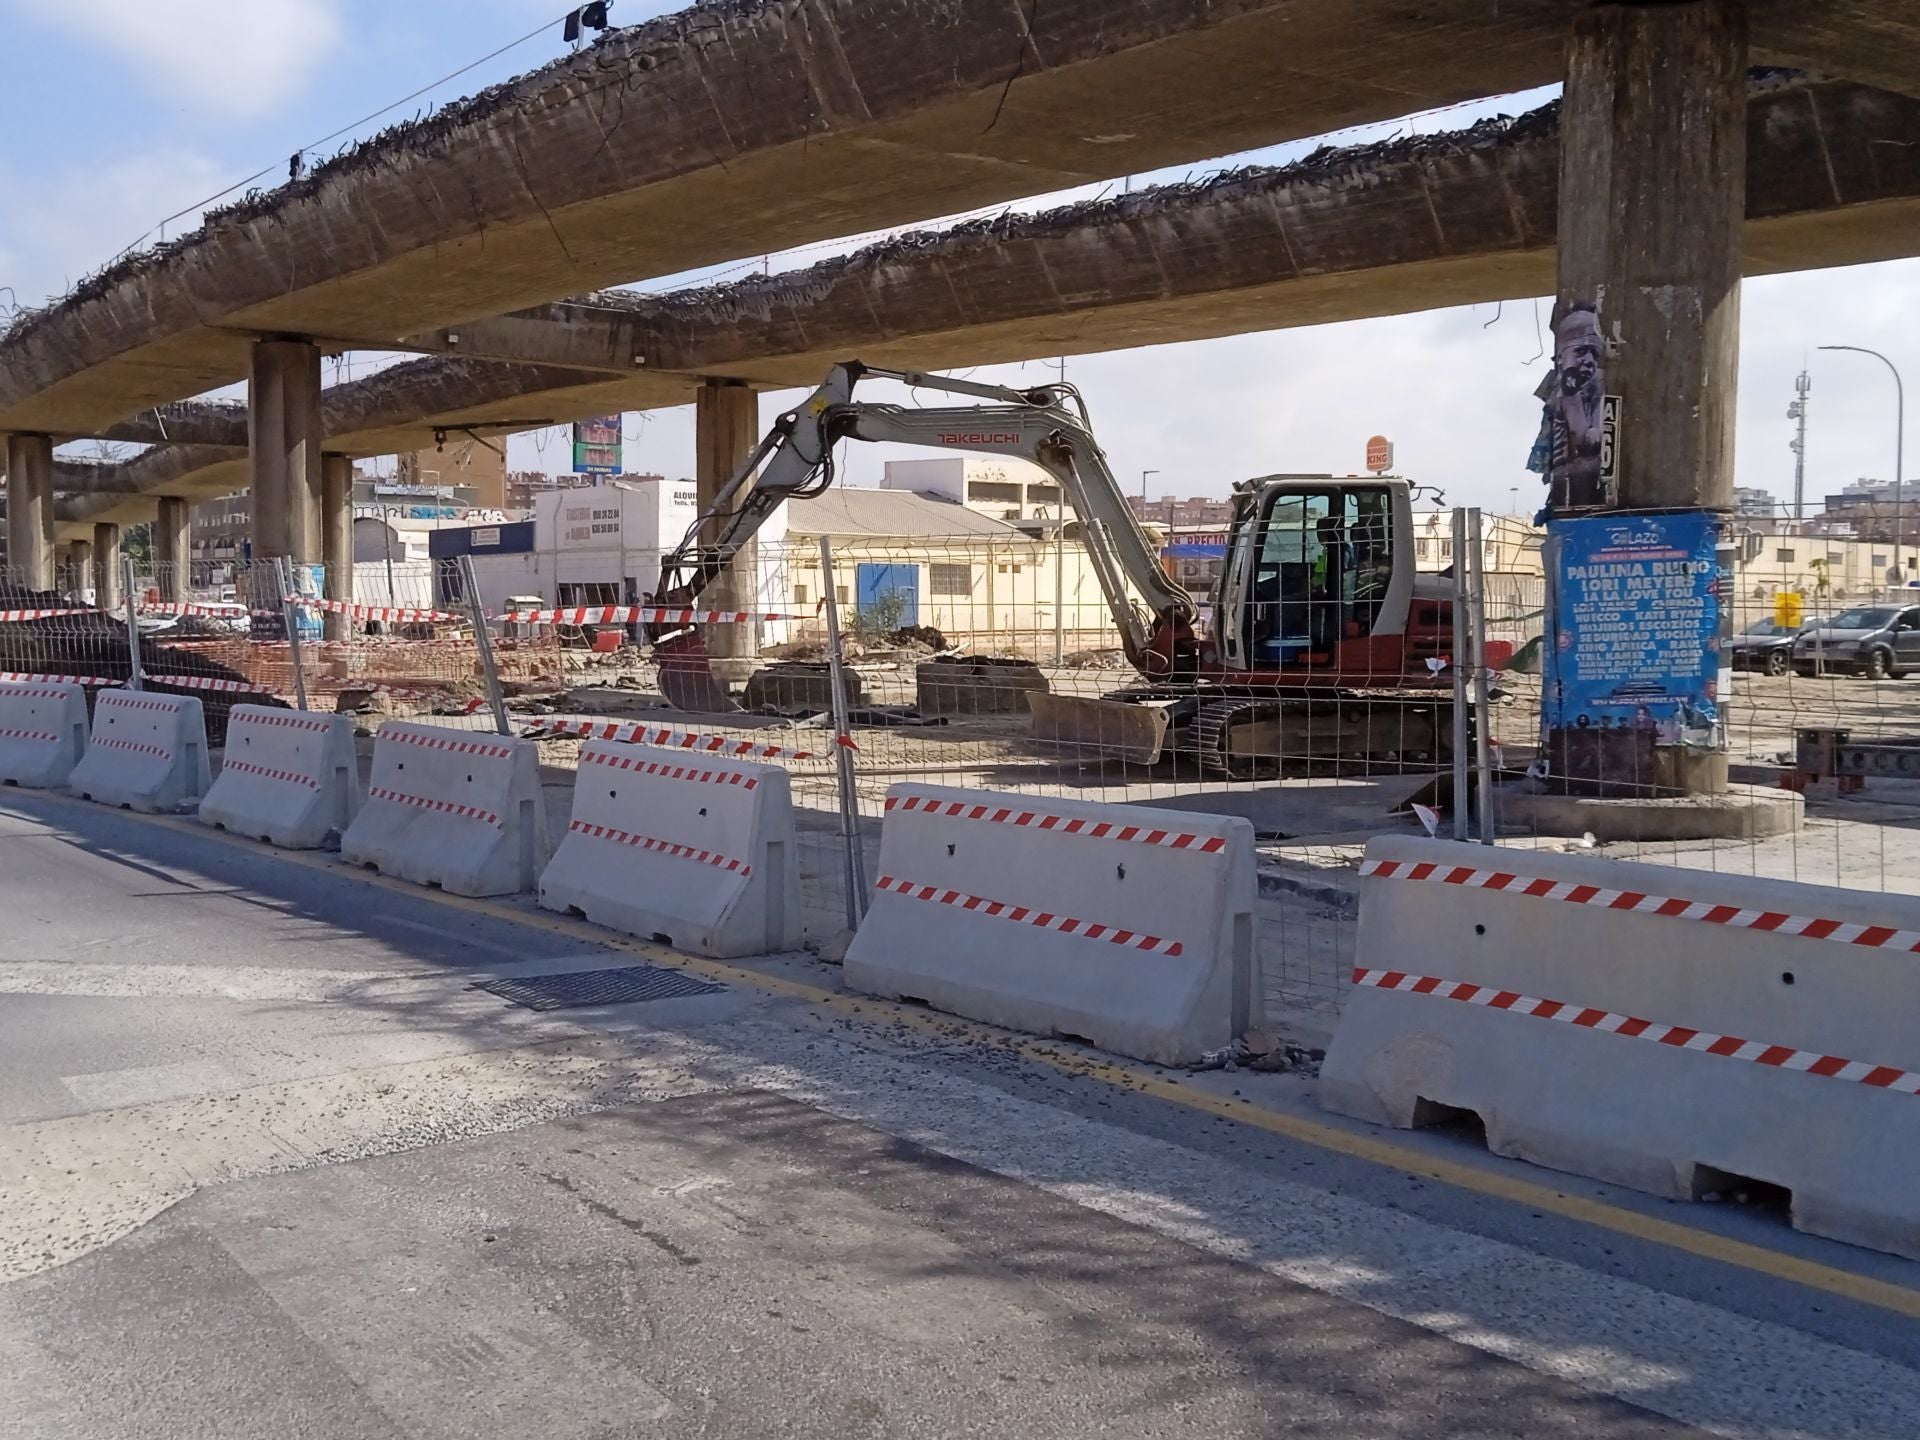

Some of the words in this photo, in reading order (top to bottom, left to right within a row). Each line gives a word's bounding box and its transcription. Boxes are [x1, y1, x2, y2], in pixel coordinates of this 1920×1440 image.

[1367, 454, 1388, 464] KING
[1567, 562, 1645, 580] PAULINA
[1582, 578, 1619, 592] LORI
[1627, 575, 1697, 591] MEYERS
[1584, 592, 1600, 602] LA
[1602, 591, 1620, 601] LA
[1624, 589, 1659, 600] LOVE
[1665, 587, 1693, 599] YOU
[1635, 609, 1666, 620] KATE
[1579, 621, 1635, 633] MOJINOS
[1580, 631, 1650, 643] SEGURIDAD
[1655, 629, 1699, 640] SOCIAL
[1578, 642, 1608, 653] KING
